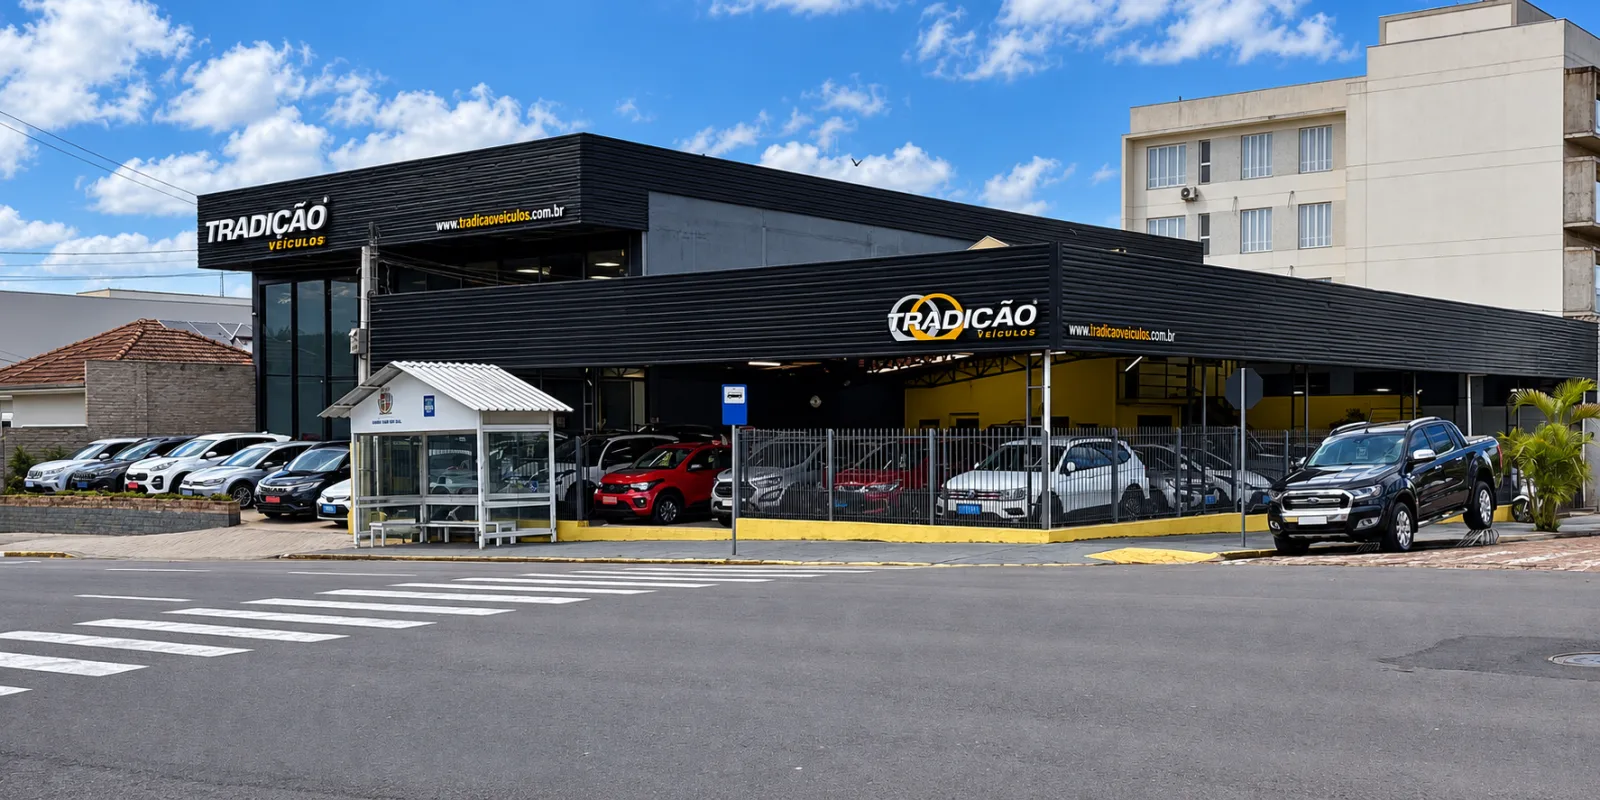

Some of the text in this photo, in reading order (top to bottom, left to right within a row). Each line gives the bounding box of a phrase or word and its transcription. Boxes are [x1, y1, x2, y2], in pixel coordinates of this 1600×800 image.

[205, 201, 327, 243] TRADIÇÃO
[435, 204, 564, 231] www.tradicaoveiculos.com.br
[268, 236, 325, 251] VEÍCULOS
[977, 328, 1036, 338] VEÍCULOS
